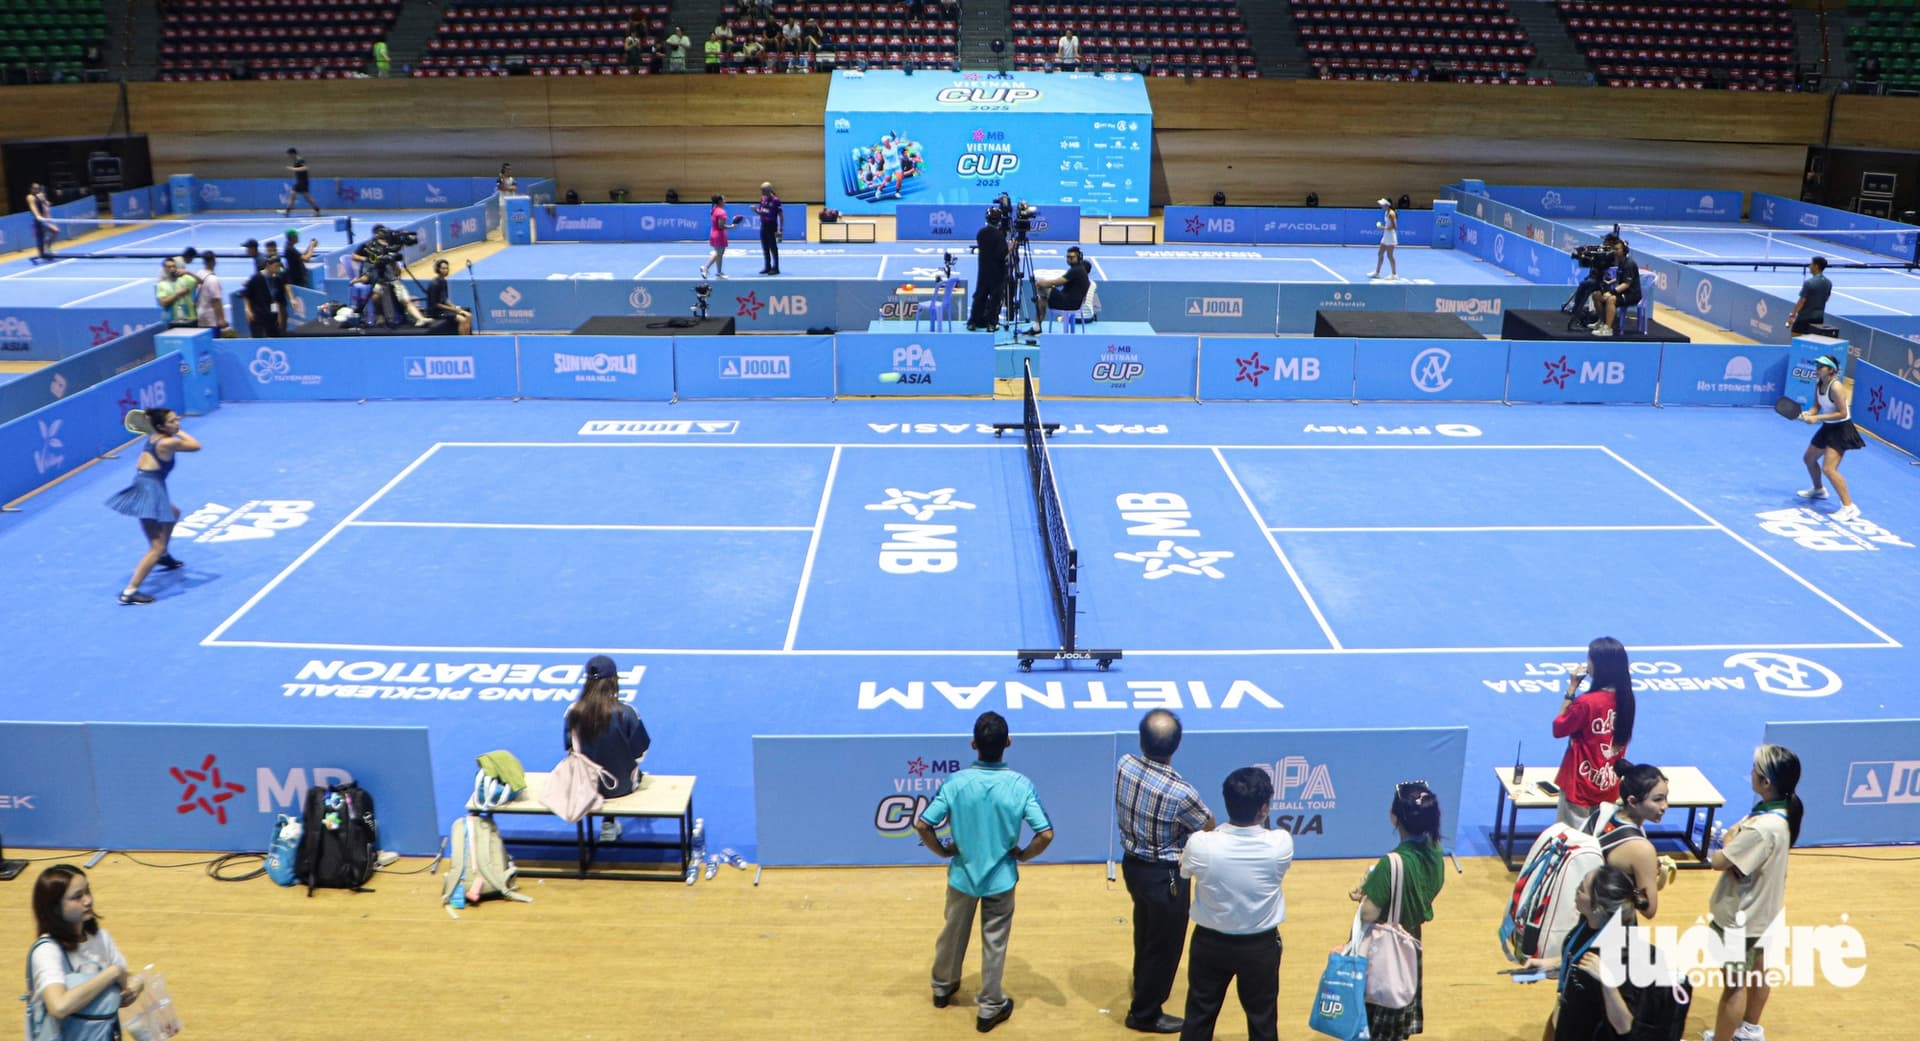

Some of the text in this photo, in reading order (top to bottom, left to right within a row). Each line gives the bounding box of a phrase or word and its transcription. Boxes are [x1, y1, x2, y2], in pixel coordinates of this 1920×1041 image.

[936, 87, 1040, 103] CUP
[987, 131, 1005, 140] MB
[966, 143, 1011, 153] VIETNAM
[957, 153, 1019, 175] CUP
[361, 188, 383, 200] MB
[462, 217, 477, 234] MB
[556, 216, 603, 231] Franklin
[657, 219, 698, 230] FPT Play
[929, 210, 955, 227] PPA
[1207, 218, 1236, 233] MB
[1466, 228, 1478, 245] MB
[768, 295, 808, 315] MB
[1204, 299, 1241, 315] JOOLA
[892, 344, 937, 367] PPA
[1117, 345, 1131, 353] MB
[1101, 354, 1138, 362] VIETNAM
[428, 360, 471, 375] JOOLA
[743, 359, 788, 376] JOOLA
[1092, 362, 1144, 381] CUP
[1273, 356, 1321, 382] MB
[1579, 361, 1625, 385] MB
[896, 373, 932, 384] ASIA
[139, 381, 166, 408] MB
[1886, 397, 1915, 430] MB
[867, 423, 970, 434] ASIA
[1096, 424, 1169, 435] PPA
[1303, 423, 1432, 436] FPT Play
[1116, 492, 1201, 537] MB
[878, 523, 958, 574] MB
[295, 660, 647, 686] FDERATION
[282, 683, 471, 700] PICKLEBALL
[1482, 679, 1561, 694] ASIA
[1631, 676, 1746, 692] AMERIC
[478, 685, 580, 701] NANG
[857, 680, 1285, 710] VIETNAM
[932, 760, 960, 774] MB
[1307, 801, 1336, 809] TOUR
